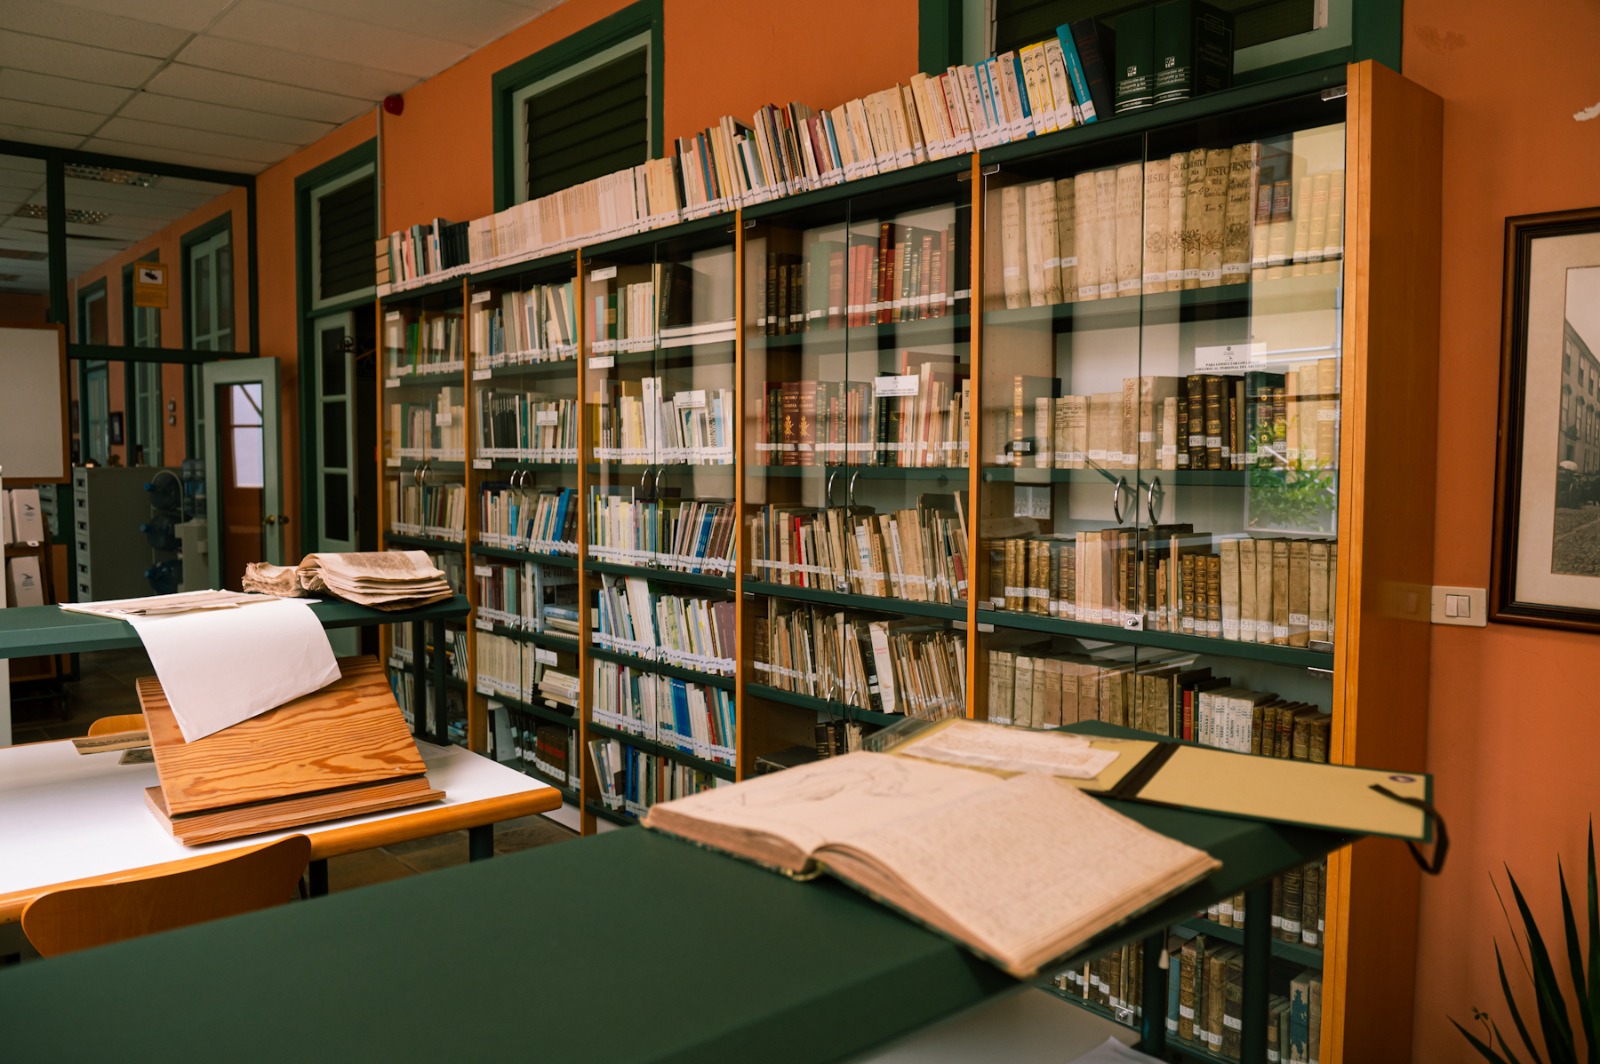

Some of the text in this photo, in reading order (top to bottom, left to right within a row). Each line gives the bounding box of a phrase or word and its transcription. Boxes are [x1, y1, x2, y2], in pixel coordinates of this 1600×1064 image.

[1290, 615, 1306, 624] 542
[1311, 621, 1324, 630] 543
[1275, 628, 1287, 636] 541
